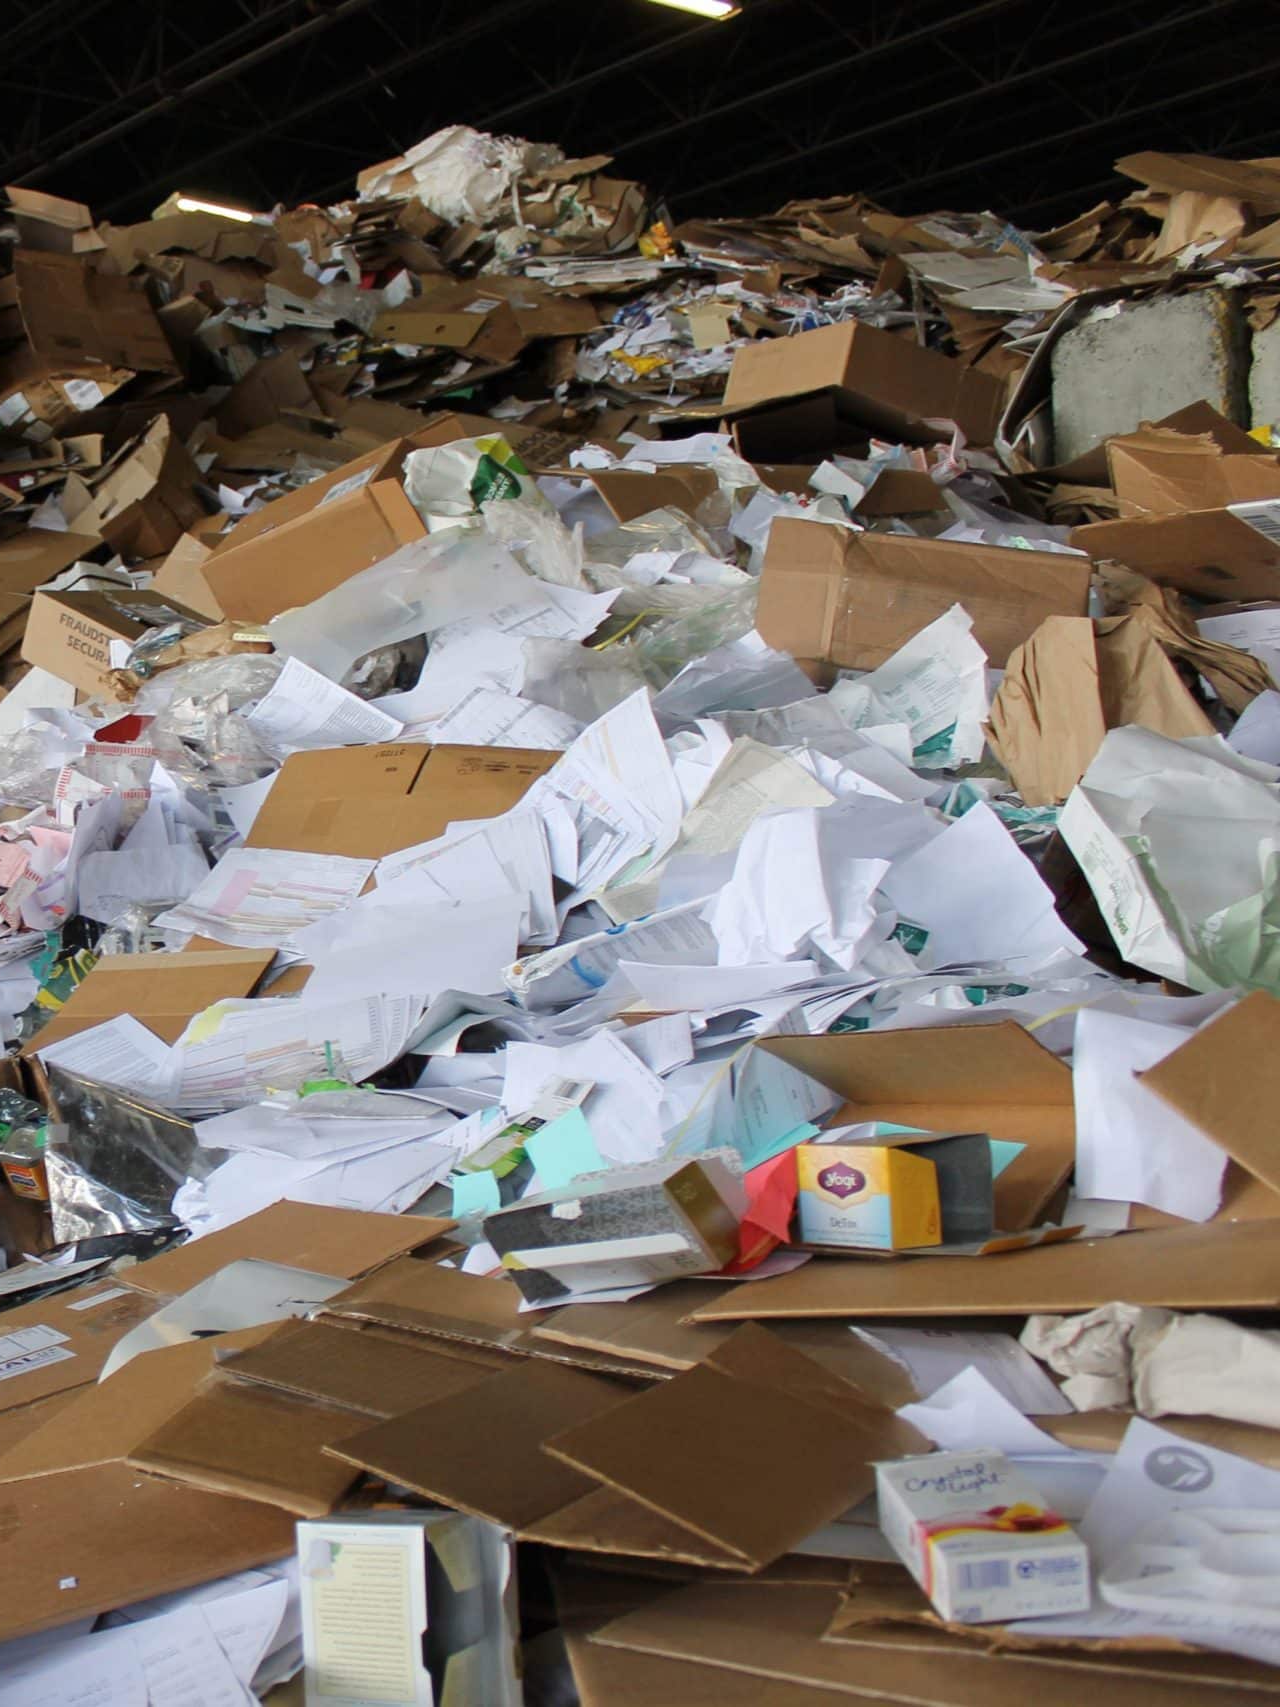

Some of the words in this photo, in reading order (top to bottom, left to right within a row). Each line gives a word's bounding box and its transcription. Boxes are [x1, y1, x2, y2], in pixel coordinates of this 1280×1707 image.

[824, 1172, 856, 1190] Yogi
[904, 1462, 985, 1493] Crystal
[948, 1471, 1004, 1494] Light
